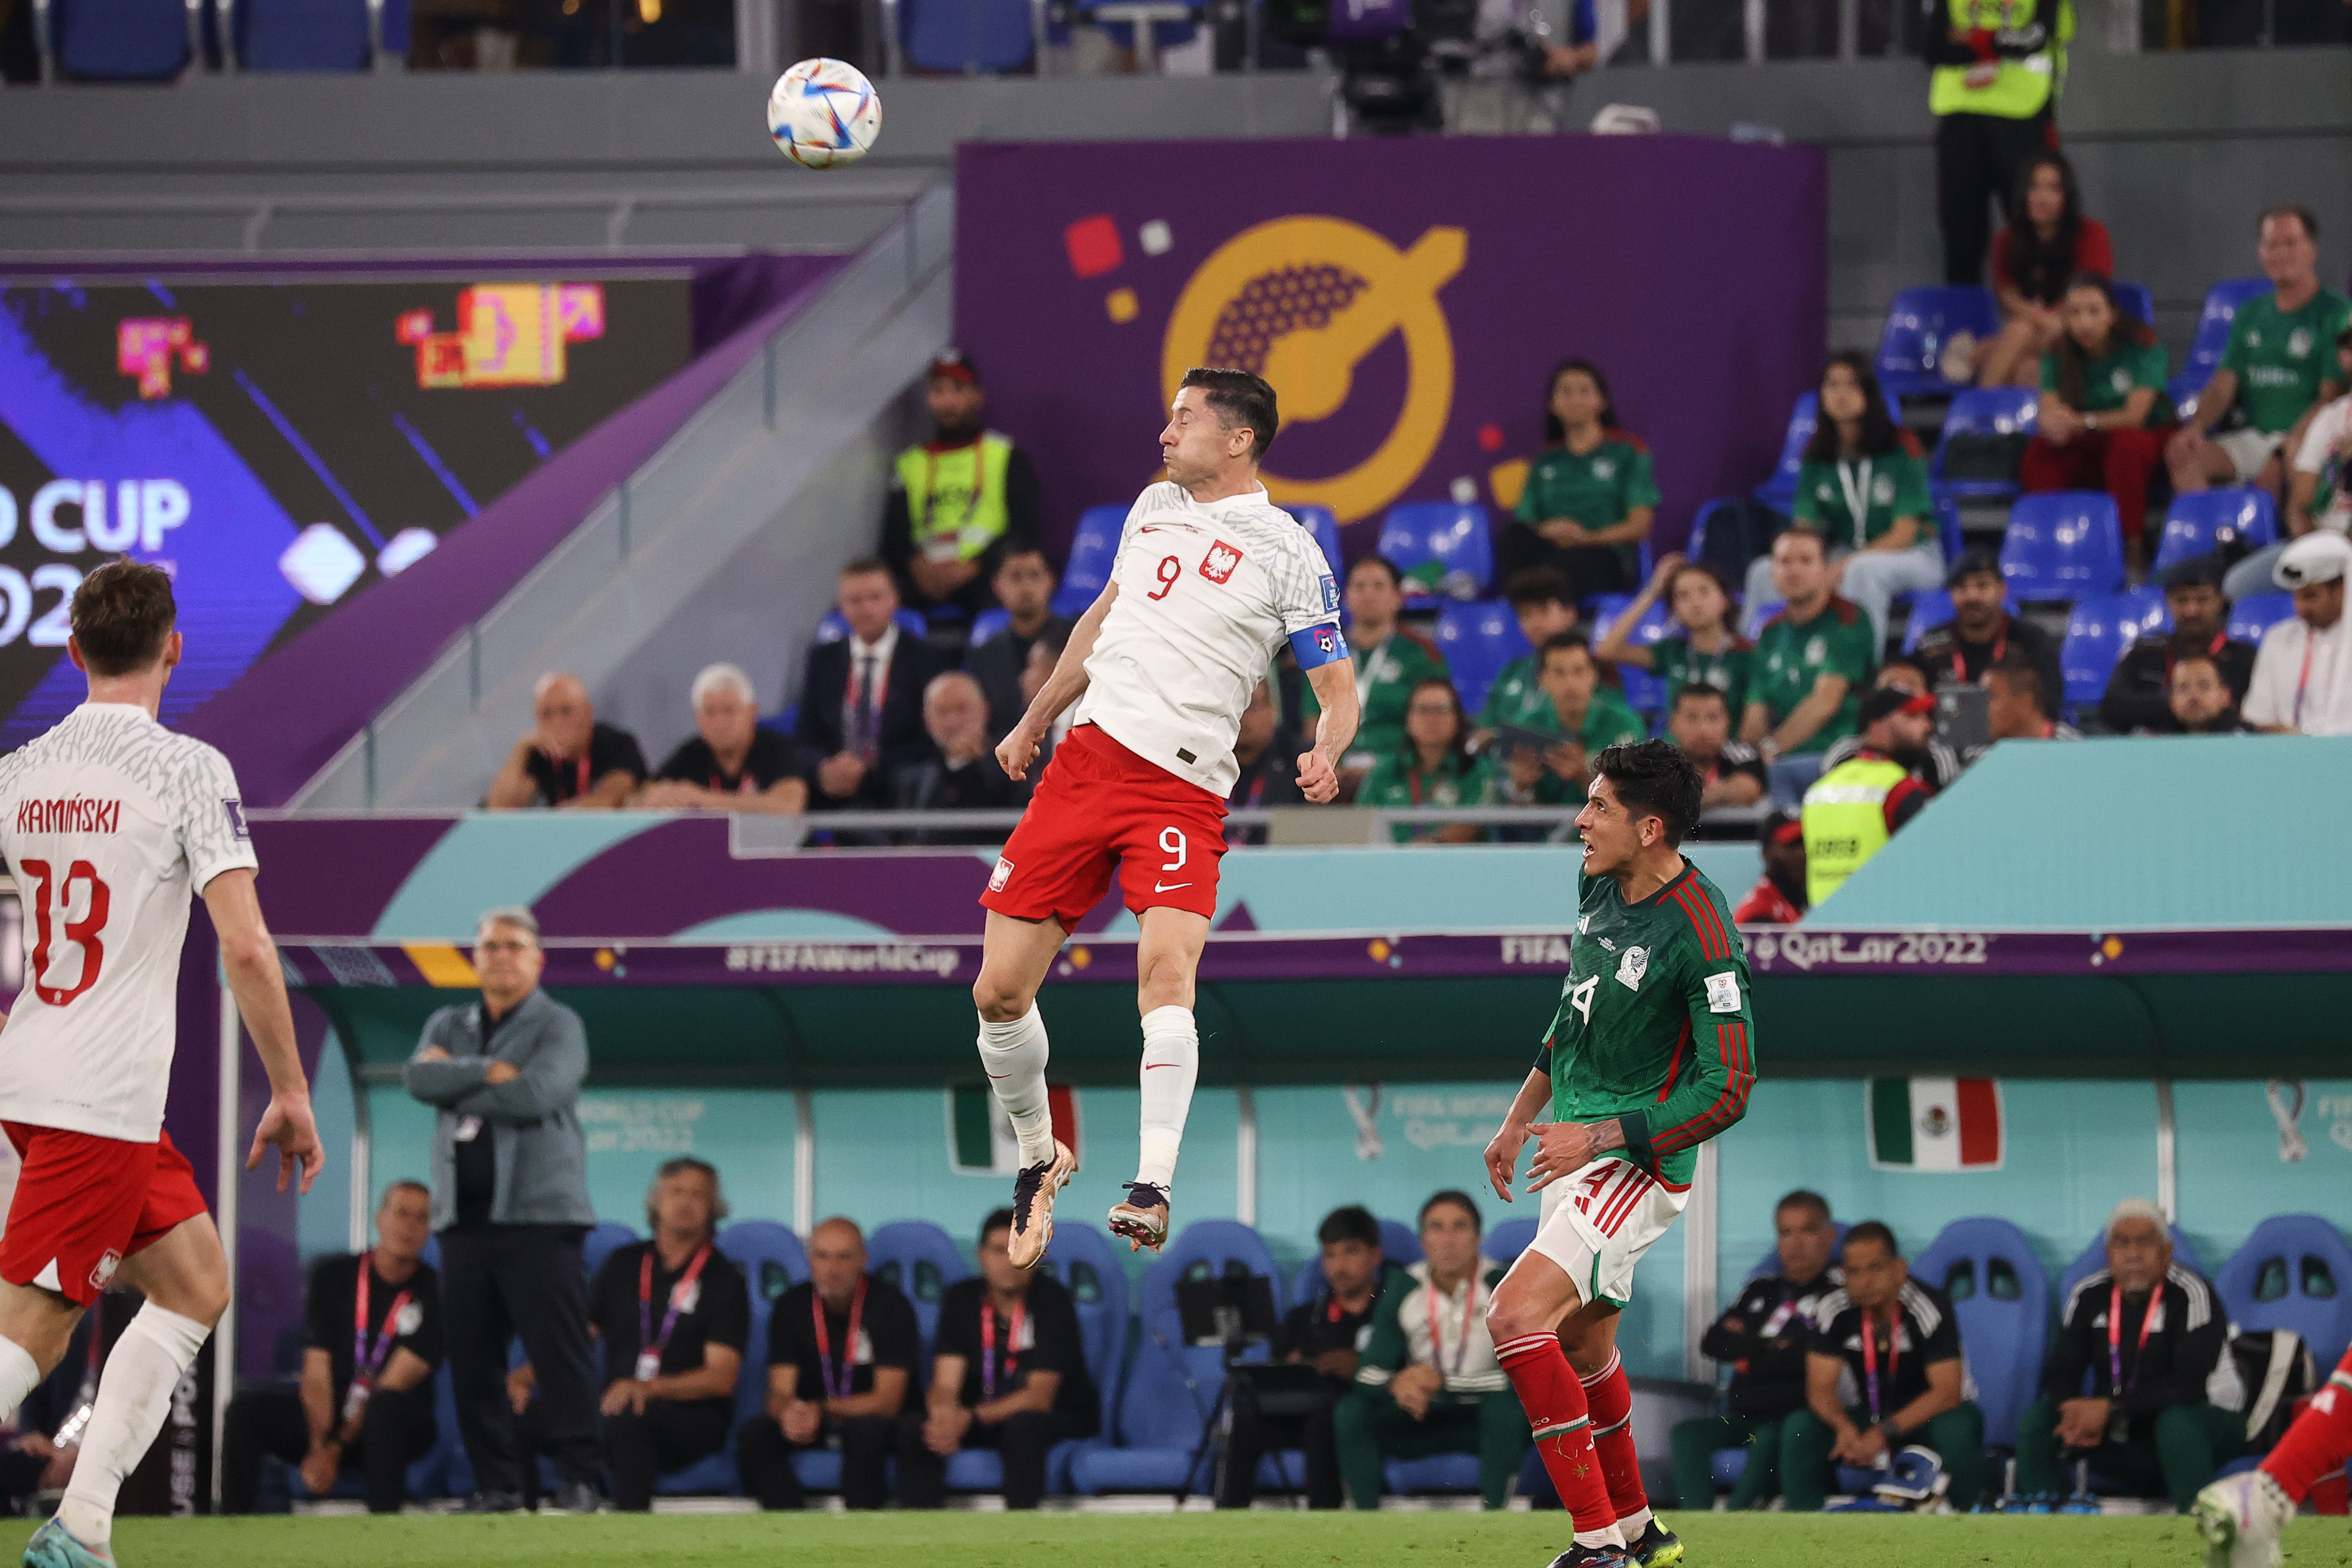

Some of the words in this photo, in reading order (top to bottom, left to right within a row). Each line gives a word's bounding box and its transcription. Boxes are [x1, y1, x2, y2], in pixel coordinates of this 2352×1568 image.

[29, 478, 191, 553] CUP
[1147, 555, 1181, 601] 9
[17, 792, 121, 834] KAMIŃSKI
[1158, 825, 1188, 871] 9
[20, 858, 111, 1007] 13
[1571, 974, 1600, 1027] 4
[1578, 1159, 1622, 1199] 4
